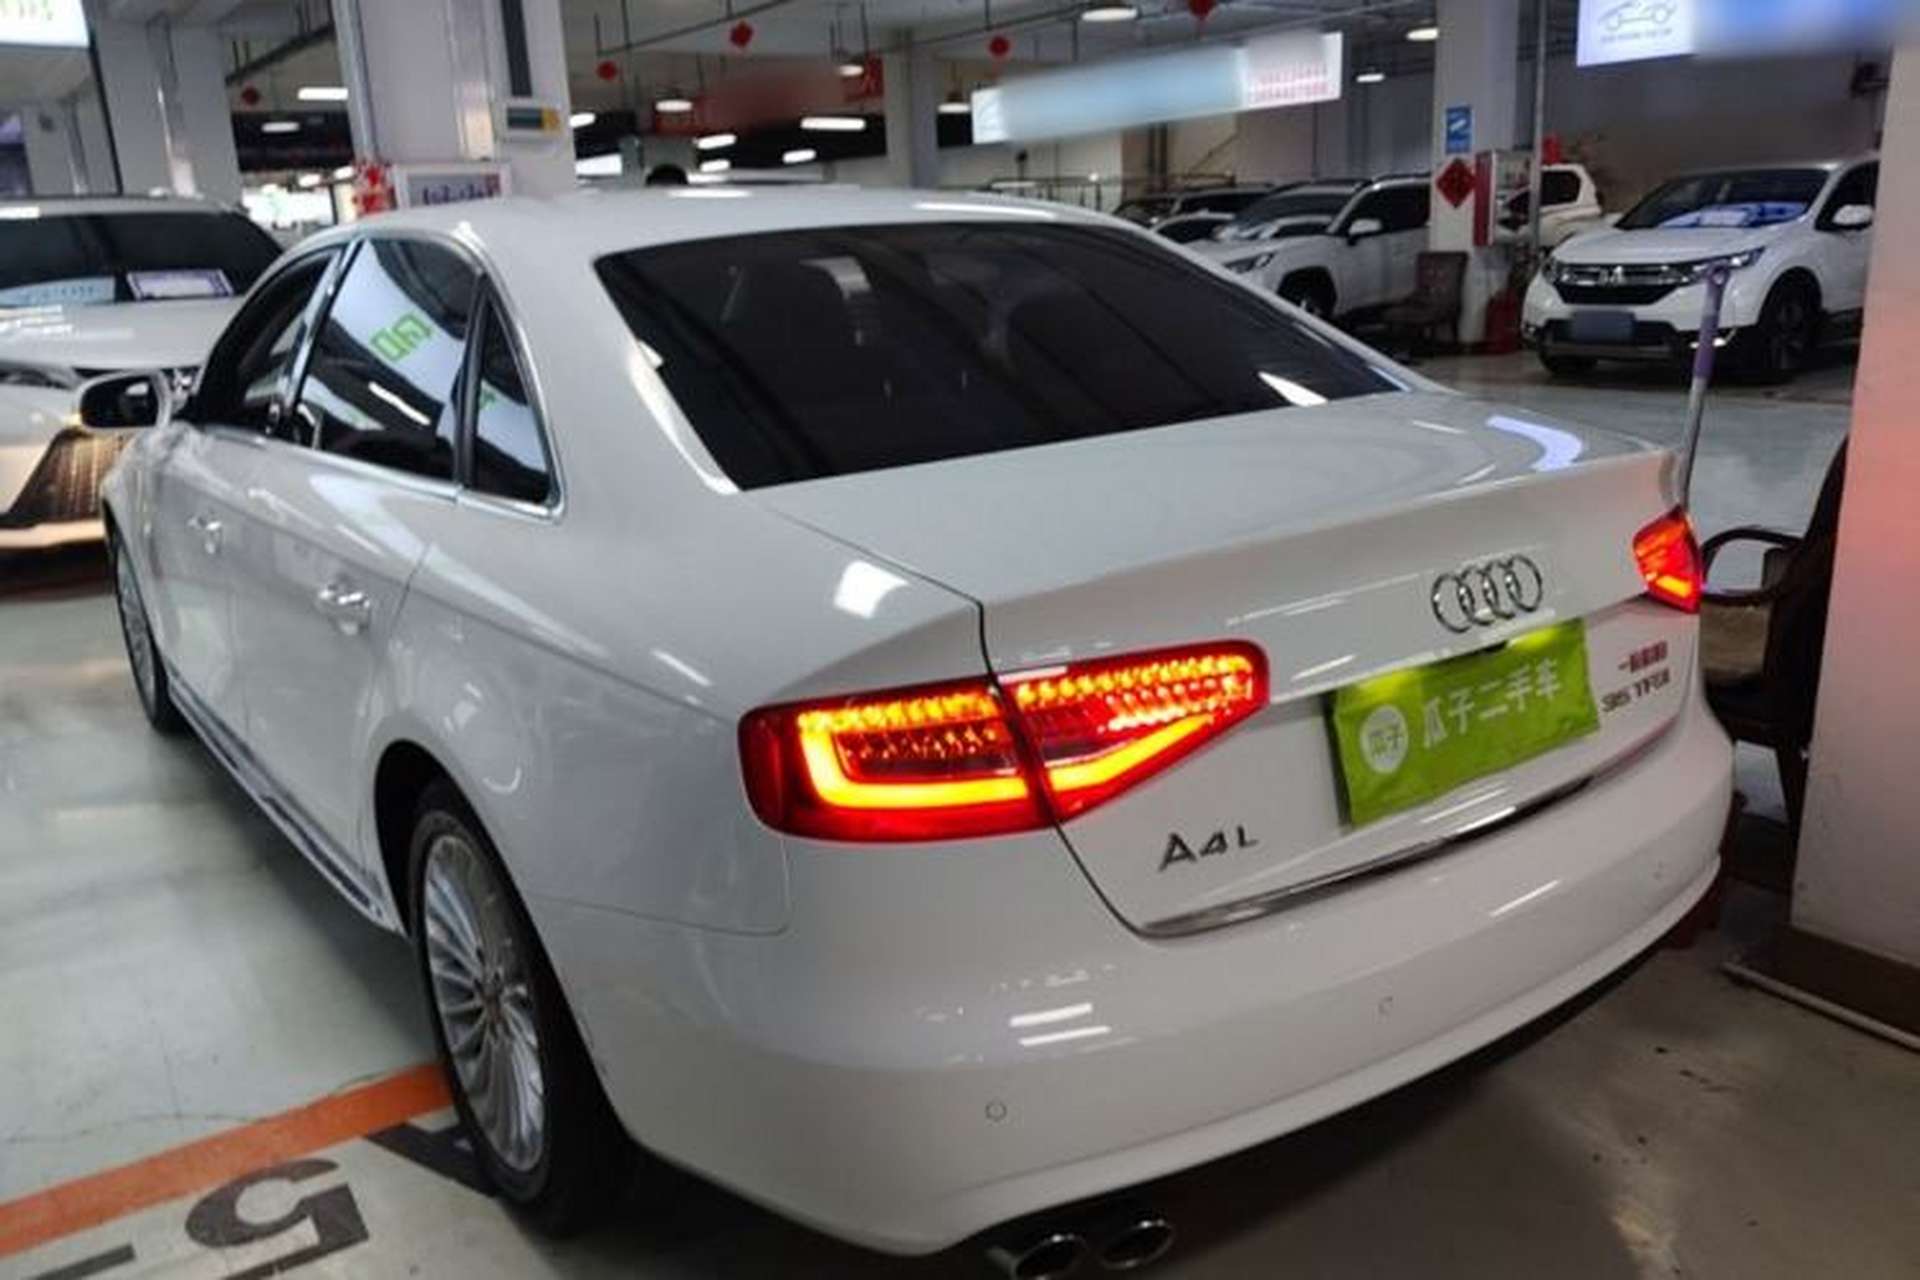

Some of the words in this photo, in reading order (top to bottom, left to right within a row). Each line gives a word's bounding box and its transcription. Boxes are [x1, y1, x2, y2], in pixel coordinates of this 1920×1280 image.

[1422, 657, 1561, 748] 瓜子二手车
[1157, 823, 1259, 872] A4L
